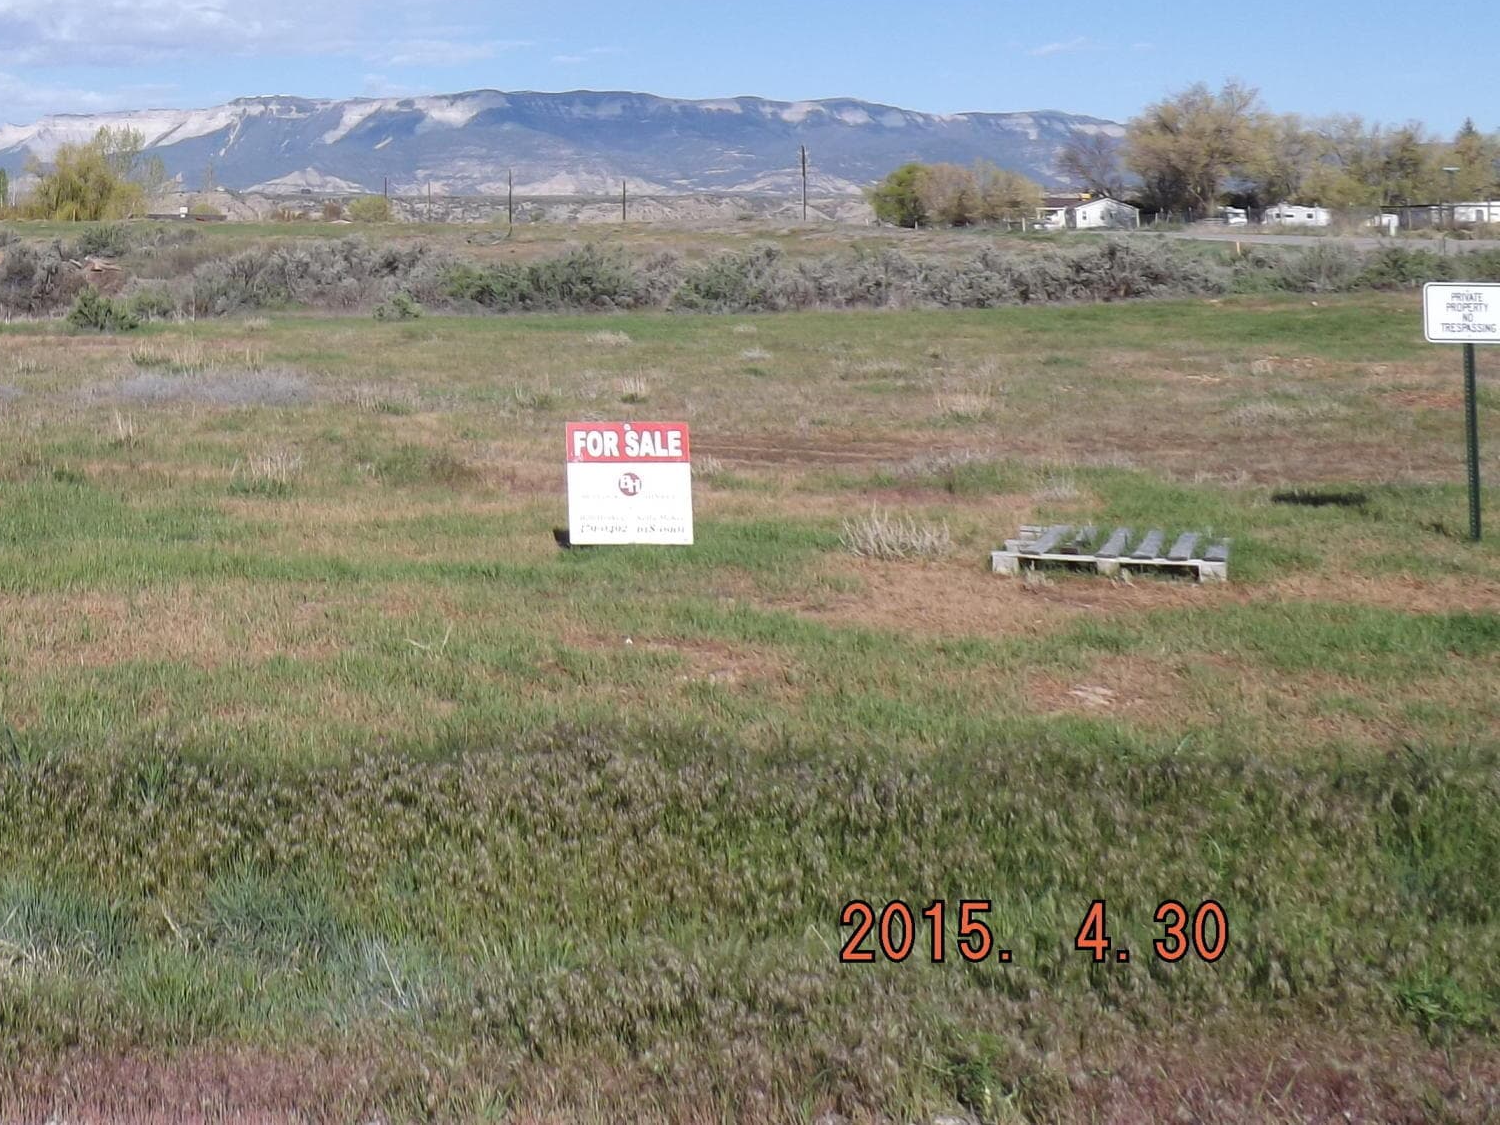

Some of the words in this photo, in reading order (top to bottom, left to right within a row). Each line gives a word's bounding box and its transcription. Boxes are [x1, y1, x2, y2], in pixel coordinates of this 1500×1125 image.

[1451, 292, 1484, 302] PRIVATE
[1446, 302, 1488, 312] PROPERTY
[1462, 313, 1474, 322] NO
[1441, 323, 1497, 333] TRESPASSING
[573, 430, 620, 457] FOR
[624, 430, 683, 457] SALE
